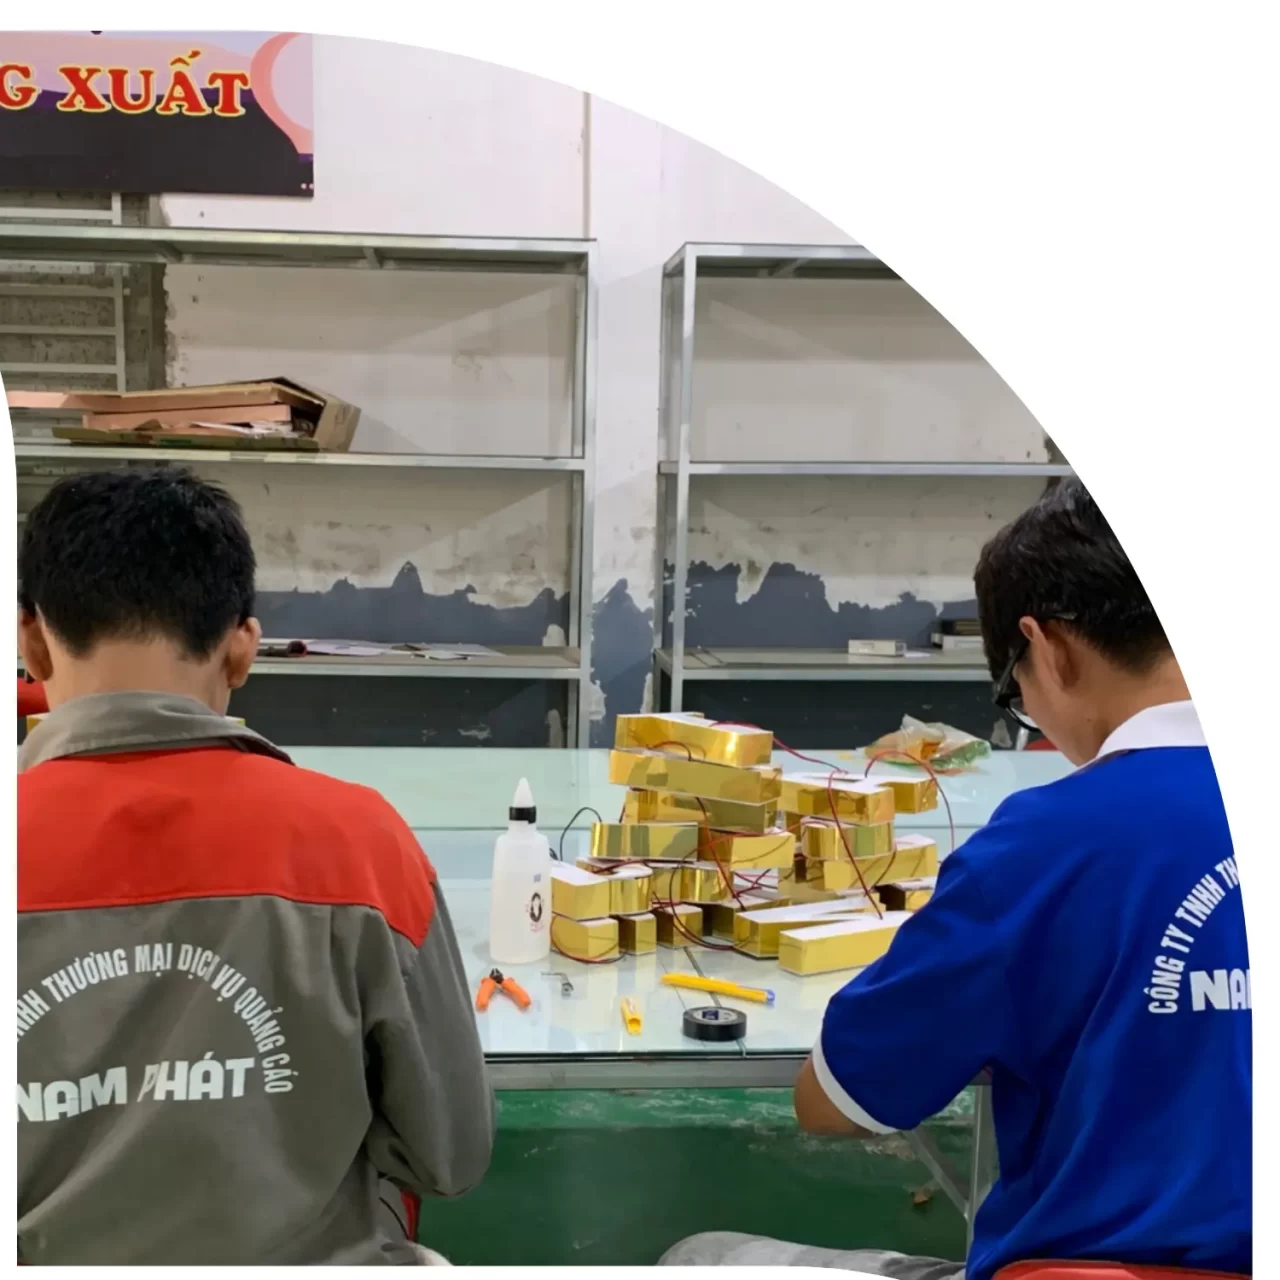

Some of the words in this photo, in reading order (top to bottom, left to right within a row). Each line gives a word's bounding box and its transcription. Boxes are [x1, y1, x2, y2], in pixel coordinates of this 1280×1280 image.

[56, 49, 252, 117] XUẤT
[1174, 873, 1226, 928] TNHH
[1160, 922, 1194, 954] TY
[1143, 954, 1186, 1014] CÔNG
[1189, 968, 1252, 1012] NA
[41, 948, 129, 1003] THƯƠNG
[134, 943, 173, 977] MẠI
[211, 963, 248, 1002] VỤ
[233, 986, 286, 1053] QUẢNG
[262, 1052, 299, 1094] CÁO
[17, 1066, 128, 1122] NAM
[137, 1051, 255, 1103] PHÁT
